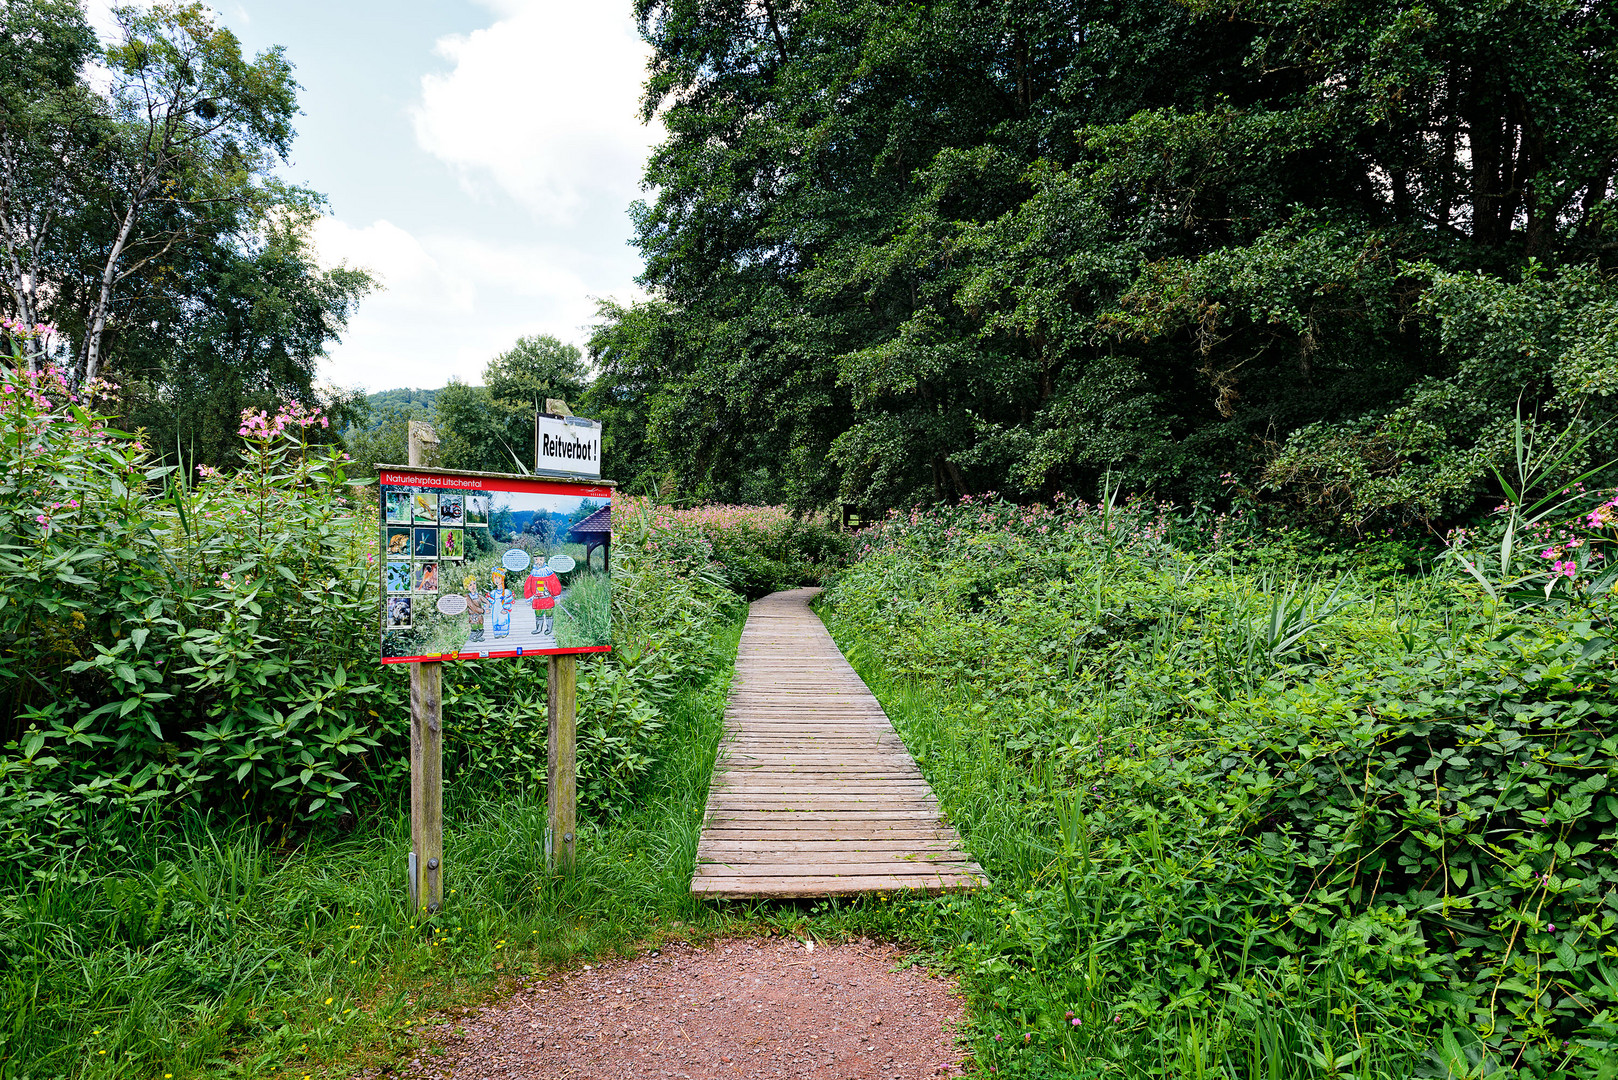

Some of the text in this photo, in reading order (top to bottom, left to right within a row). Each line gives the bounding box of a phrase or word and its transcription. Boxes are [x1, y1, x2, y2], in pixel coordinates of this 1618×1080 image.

[542, 433, 597, 462] Reitverbot !
[386, 474, 482, 488] Naturlehrpfad Litschental
